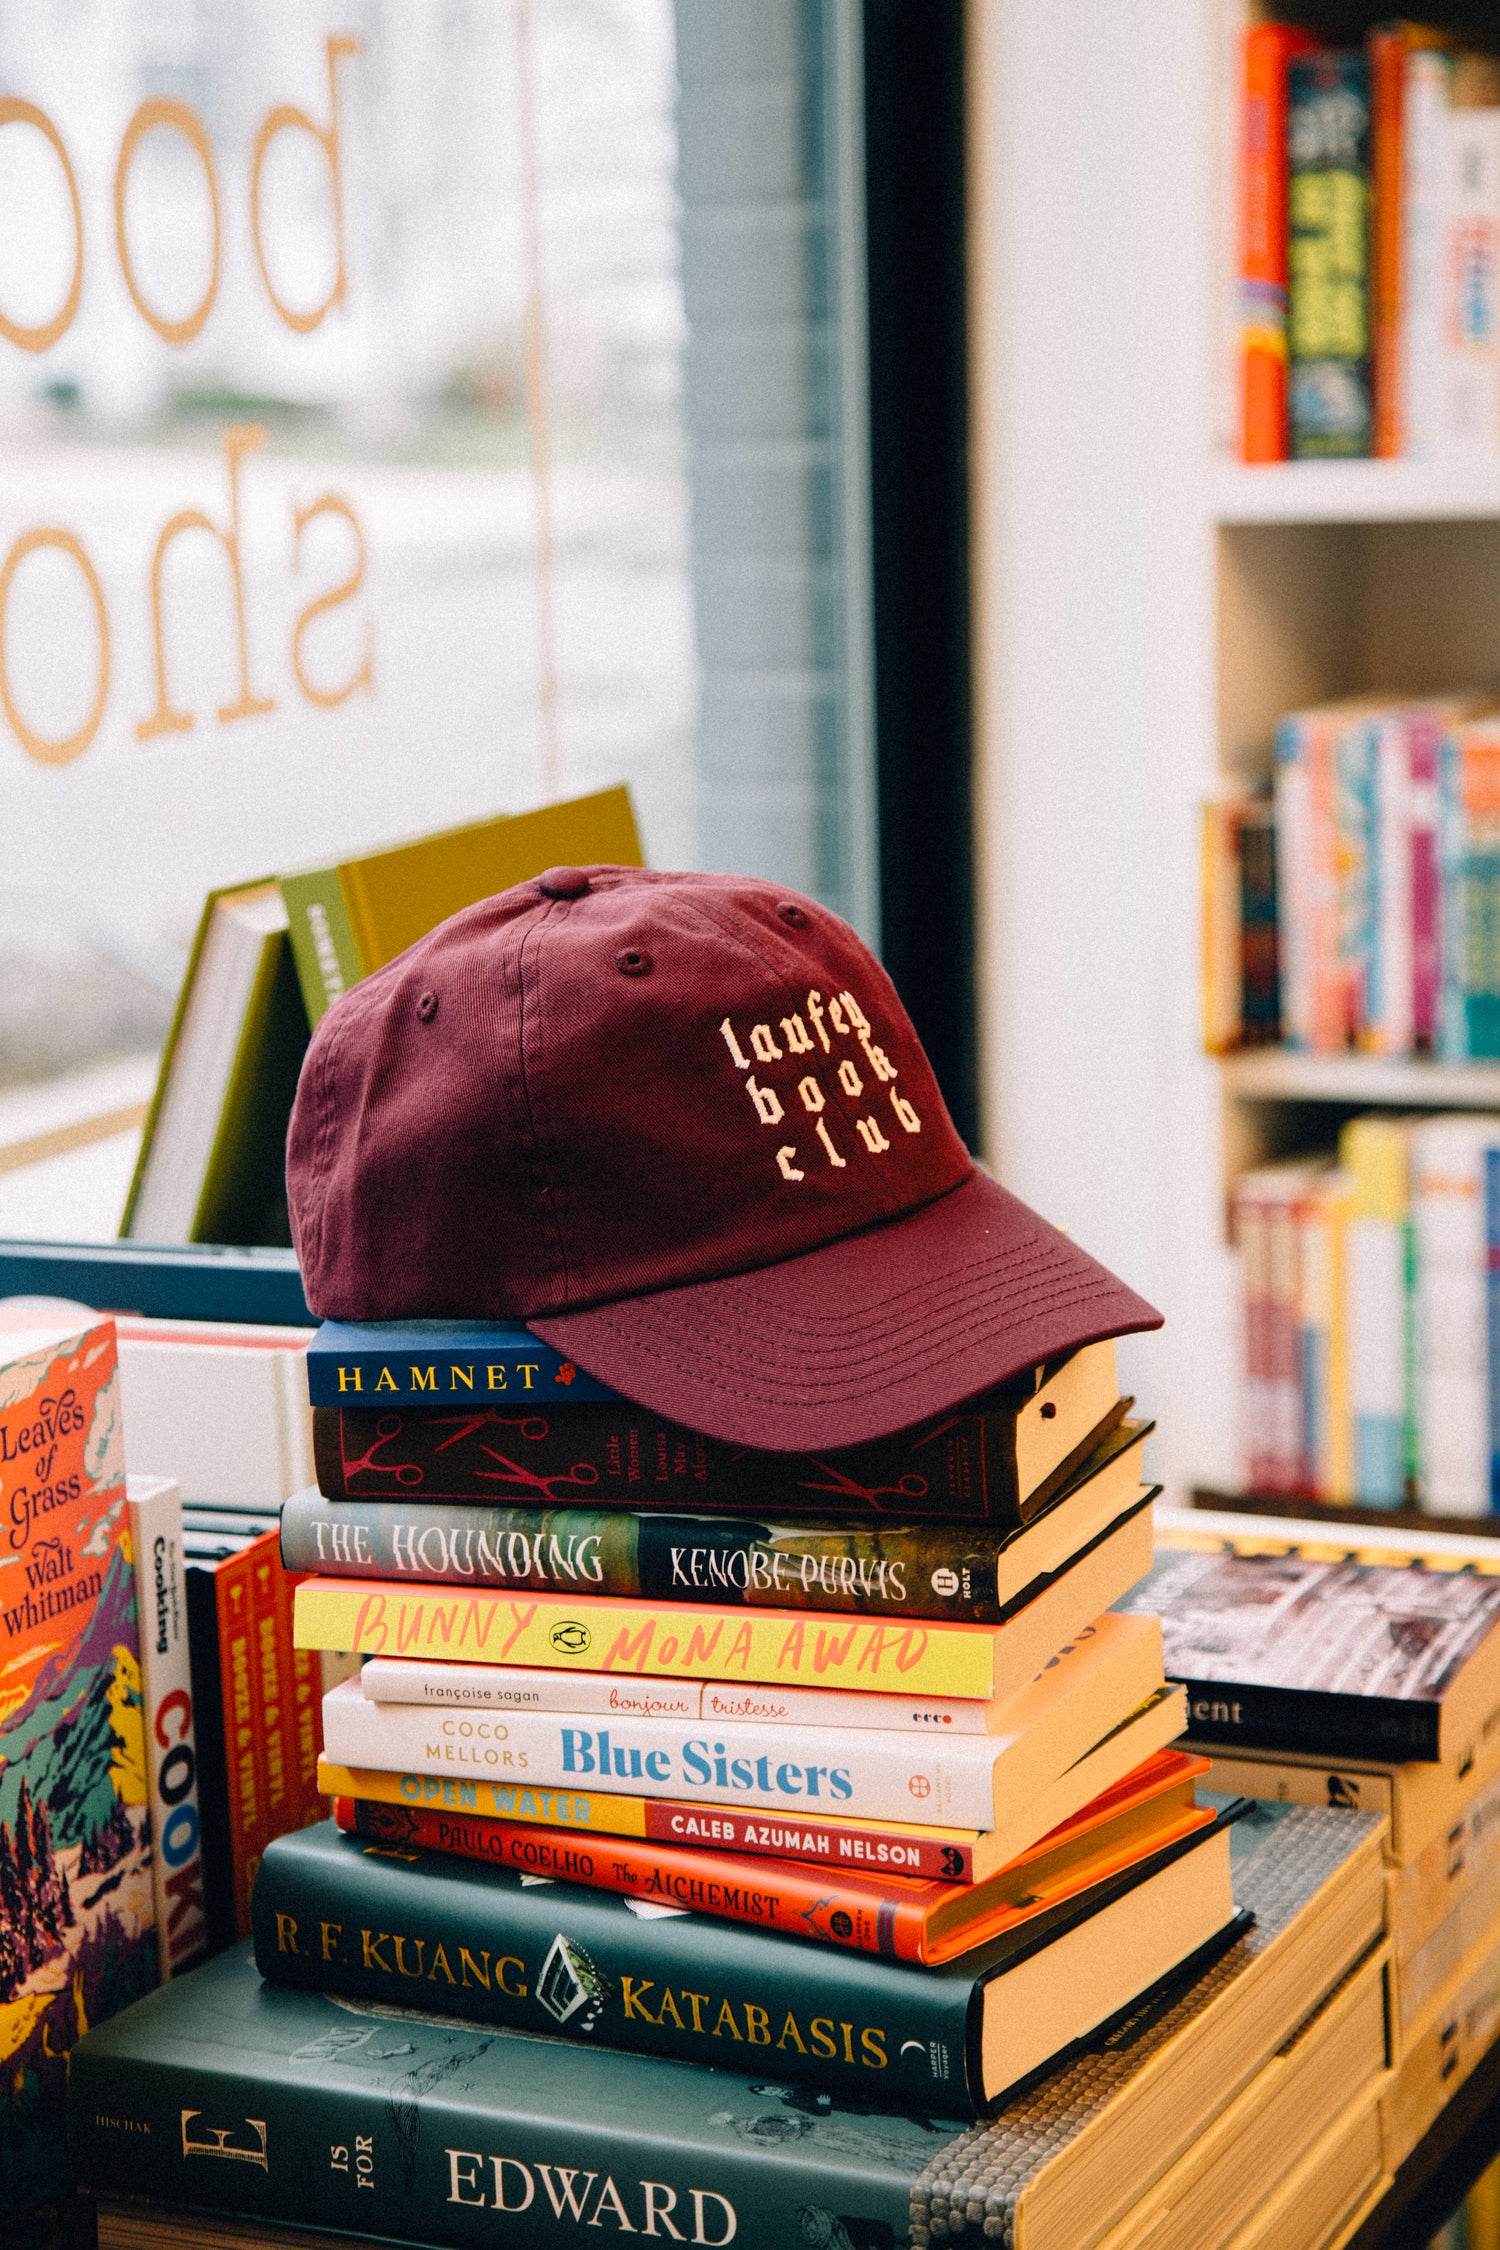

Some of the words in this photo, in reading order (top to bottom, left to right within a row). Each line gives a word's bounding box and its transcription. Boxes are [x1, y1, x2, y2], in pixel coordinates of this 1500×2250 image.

[719, 989, 872, 1070] laufey
[745, 1039, 899, 1125] book
[775, 1085, 922, 1182] club
[337, 1364, 540, 1392] HAMNET
[1, 1388, 85, 1463] Leaves
[35, 1443, 58, 1484] of
[607, 1434, 621, 1475] Little
[627, 1428, 641, 1483] Women
[654, 1432, 669, 1481] Louisa
[673, 1441, 688, 1474] May
[9, 1474, 82, 1550] Grass
[25, 1536, 74, 1592] Walt
[311, 1521, 372, 1565] THE
[392, 1524, 604, 1582] HOUNDING
[670, 1547, 790, 1591] KENOBE
[800, 1555, 907, 1601] PURVIS
[154, 1536, 168, 1655] Cooking
[962, 1567, 972, 1599] HOLT
[352, 1593, 538, 1659] BUNNY
[601, 1618, 752, 1673] MONA
[777, 1618, 928, 1674] AWAD
[424, 1684, 492, 1703] françoise
[498, 1688, 540, 1704] sagan
[609, 1688, 689, 1717] bonjour
[711, 1696, 789, 1718] tristesse
[1186, 1699, 1244, 1724] ent
[425, 1743, 529, 1768] MELLORS
[442, 1720, 509, 1741] COCO
[560, 1728, 672, 1782] Blue
[682, 1740, 854, 1800] Sisters
[400, 1775, 477, 1808] OPEN
[492, 1786, 591, 1824] WATER
[671, 1815, 735, 1841] CALEB
[744, 1825, 830, 1854] AZUMAH
[839, 1838, 921, 1867] NELSON
[438, 1823, 503, 1858] PAULO
[511, 1839, 594, 1878] COELHO
[612, 1862, 639, 1885] The
[645, 1868, 781, 1919] ALCHEMIST
[275, 1912, 310, 1957] R.
[320, 1921, 349, 1963] F.
[360, 1928, 528, 1997] KUANG
[620, 1976, 889, 2069] KATABASIS
[929, 2041, 938, 2078] HARPER
[181, 2109, 269, 2174] E
[330, 2144, 349, 2172] IS
[355, 2134, 374, 2190] FOR
[445, 2148, 738, 2247] EDWARD
